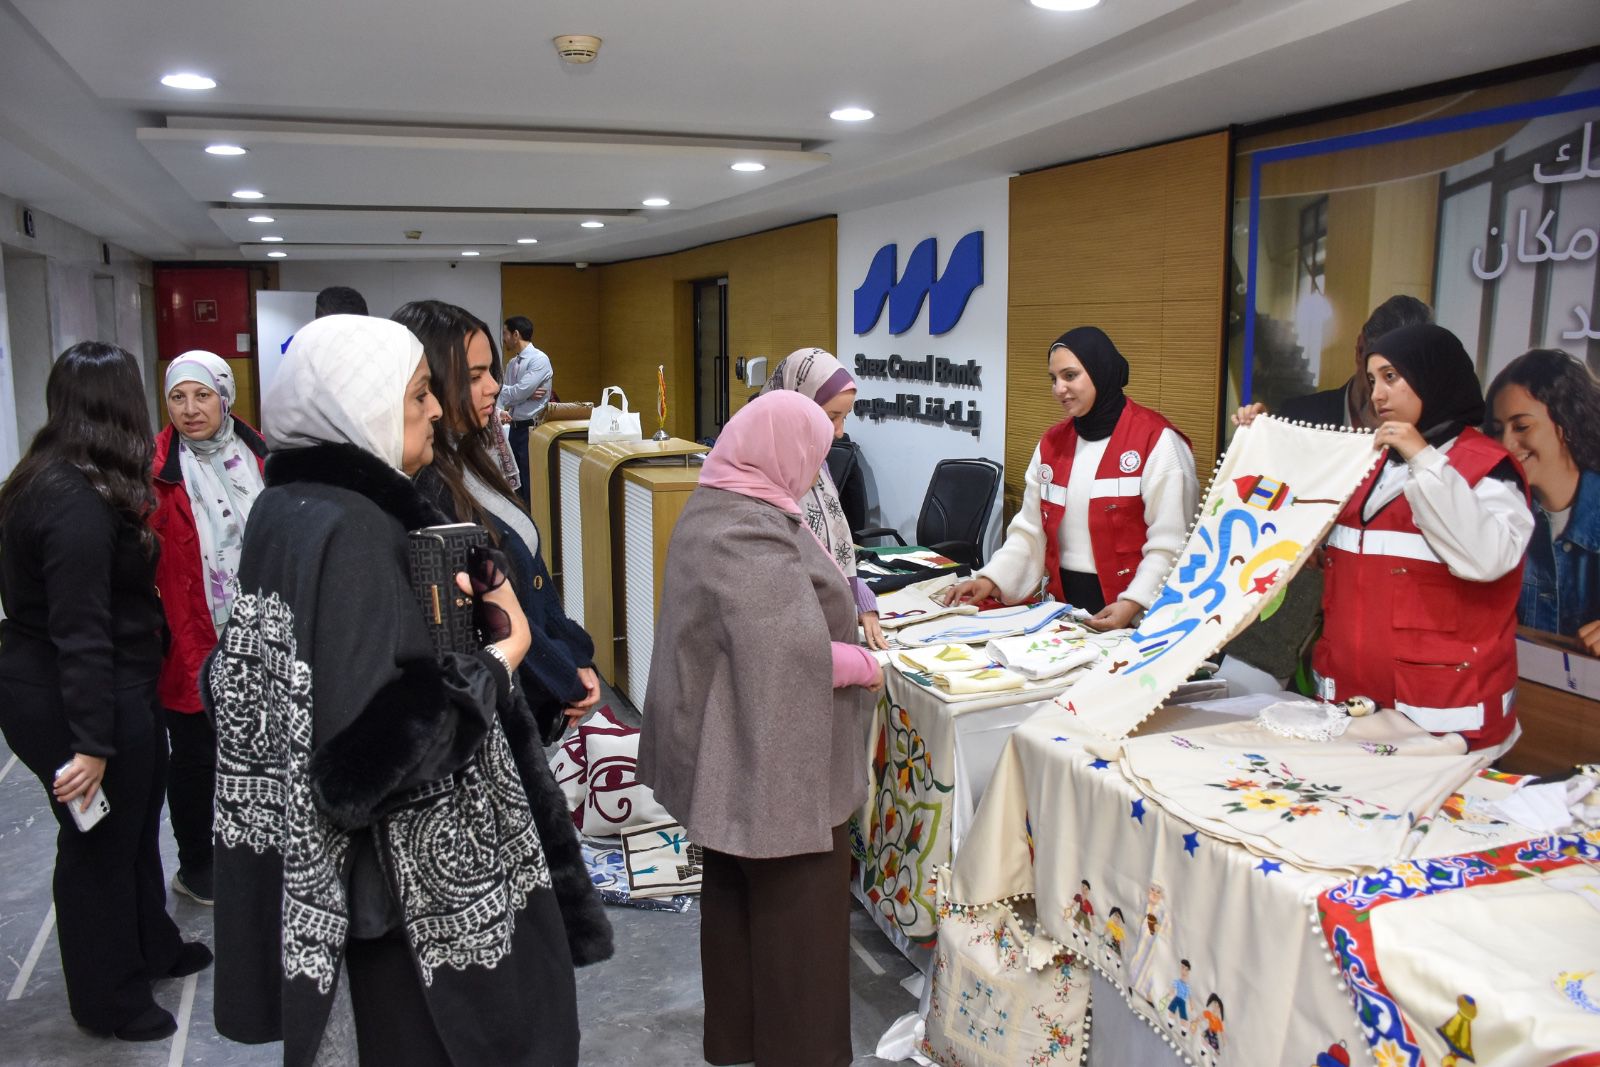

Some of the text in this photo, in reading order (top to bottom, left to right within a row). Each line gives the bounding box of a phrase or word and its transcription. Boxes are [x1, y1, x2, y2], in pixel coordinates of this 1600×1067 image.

[1472, 209, 1599, 280] مكان
[854, 353, 982, 387] Suez Canal Bank
[905, 393, 945, 424] قناة
[945, 400, 982, 437] بنك
